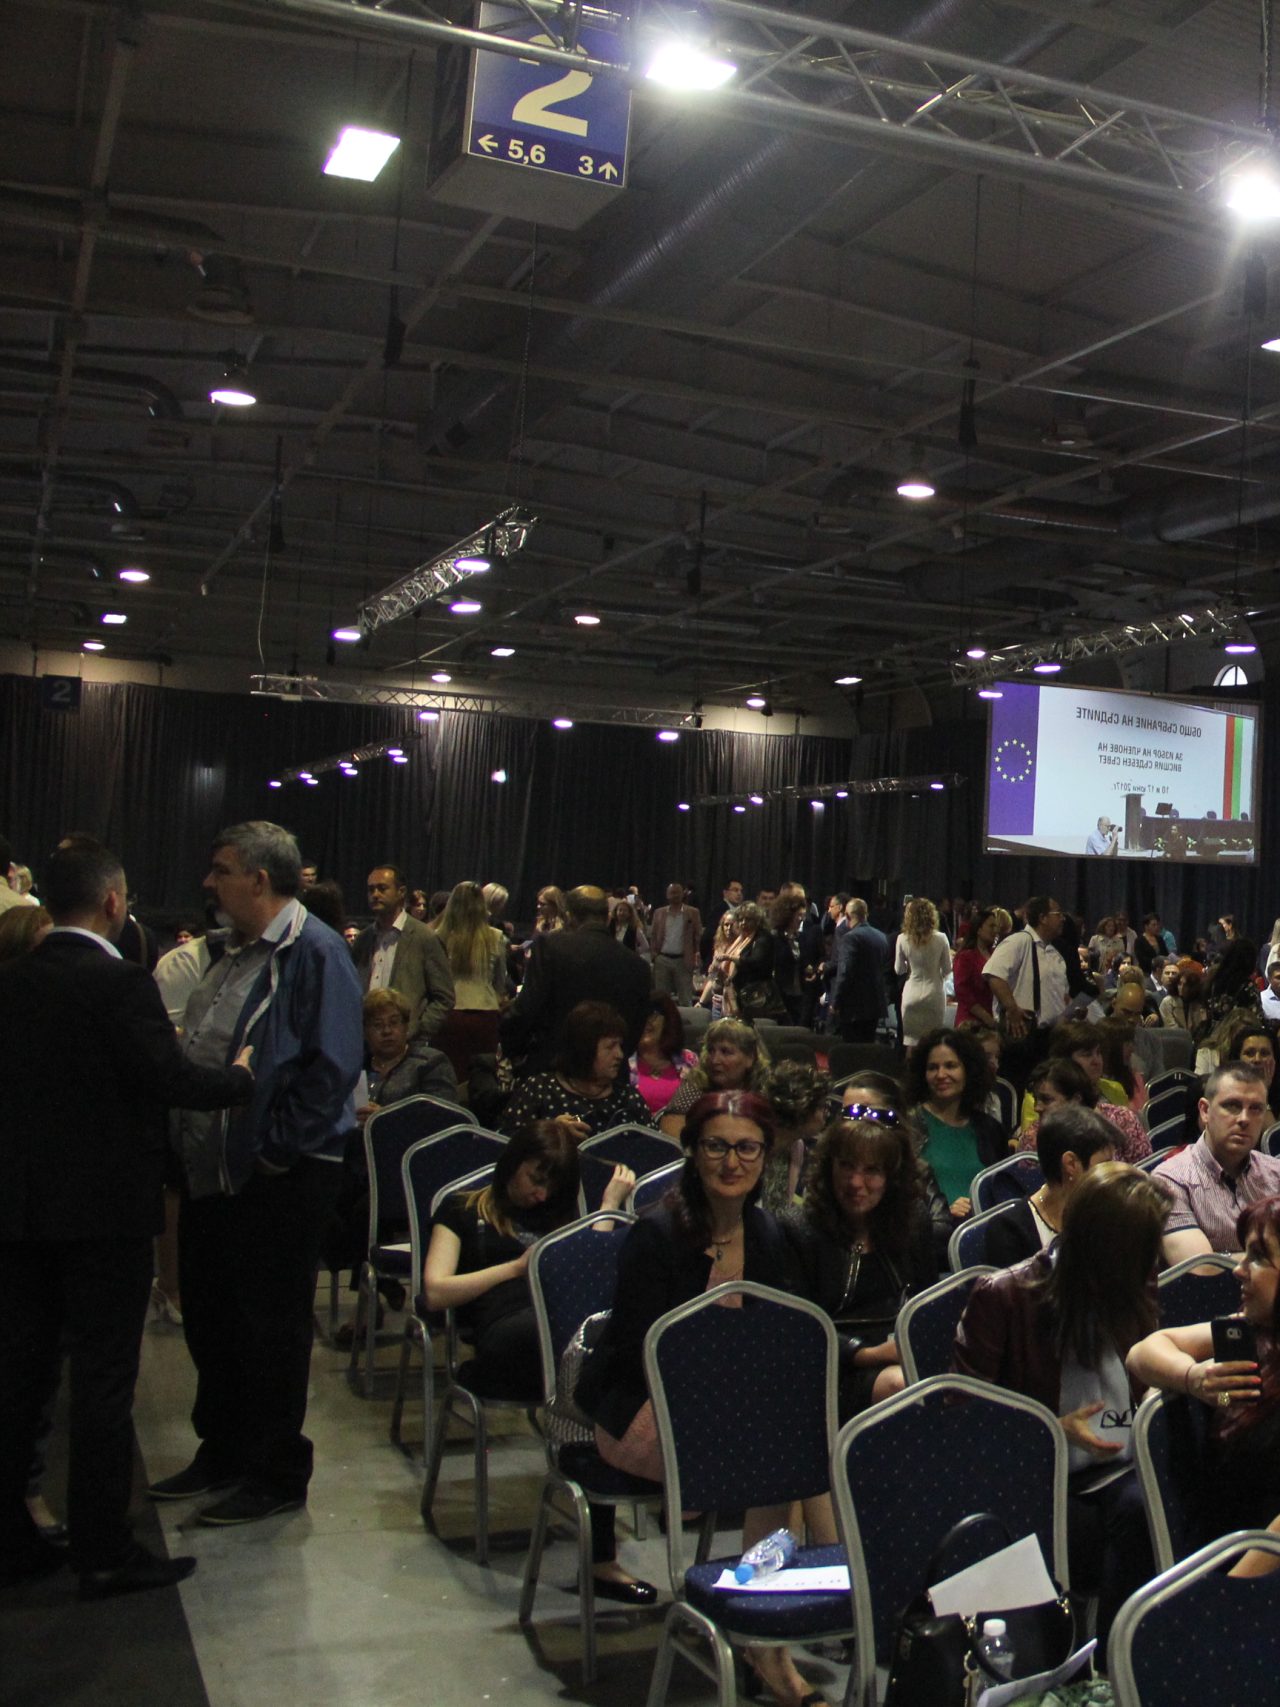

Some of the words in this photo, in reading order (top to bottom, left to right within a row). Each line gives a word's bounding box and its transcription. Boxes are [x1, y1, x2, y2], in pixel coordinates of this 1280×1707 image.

[512, 34, 593, 137] 2
[507, 138, 546, 165] 5,6
[578, 156, 593, 175] 3
[51, 679, 72, 702] 2
